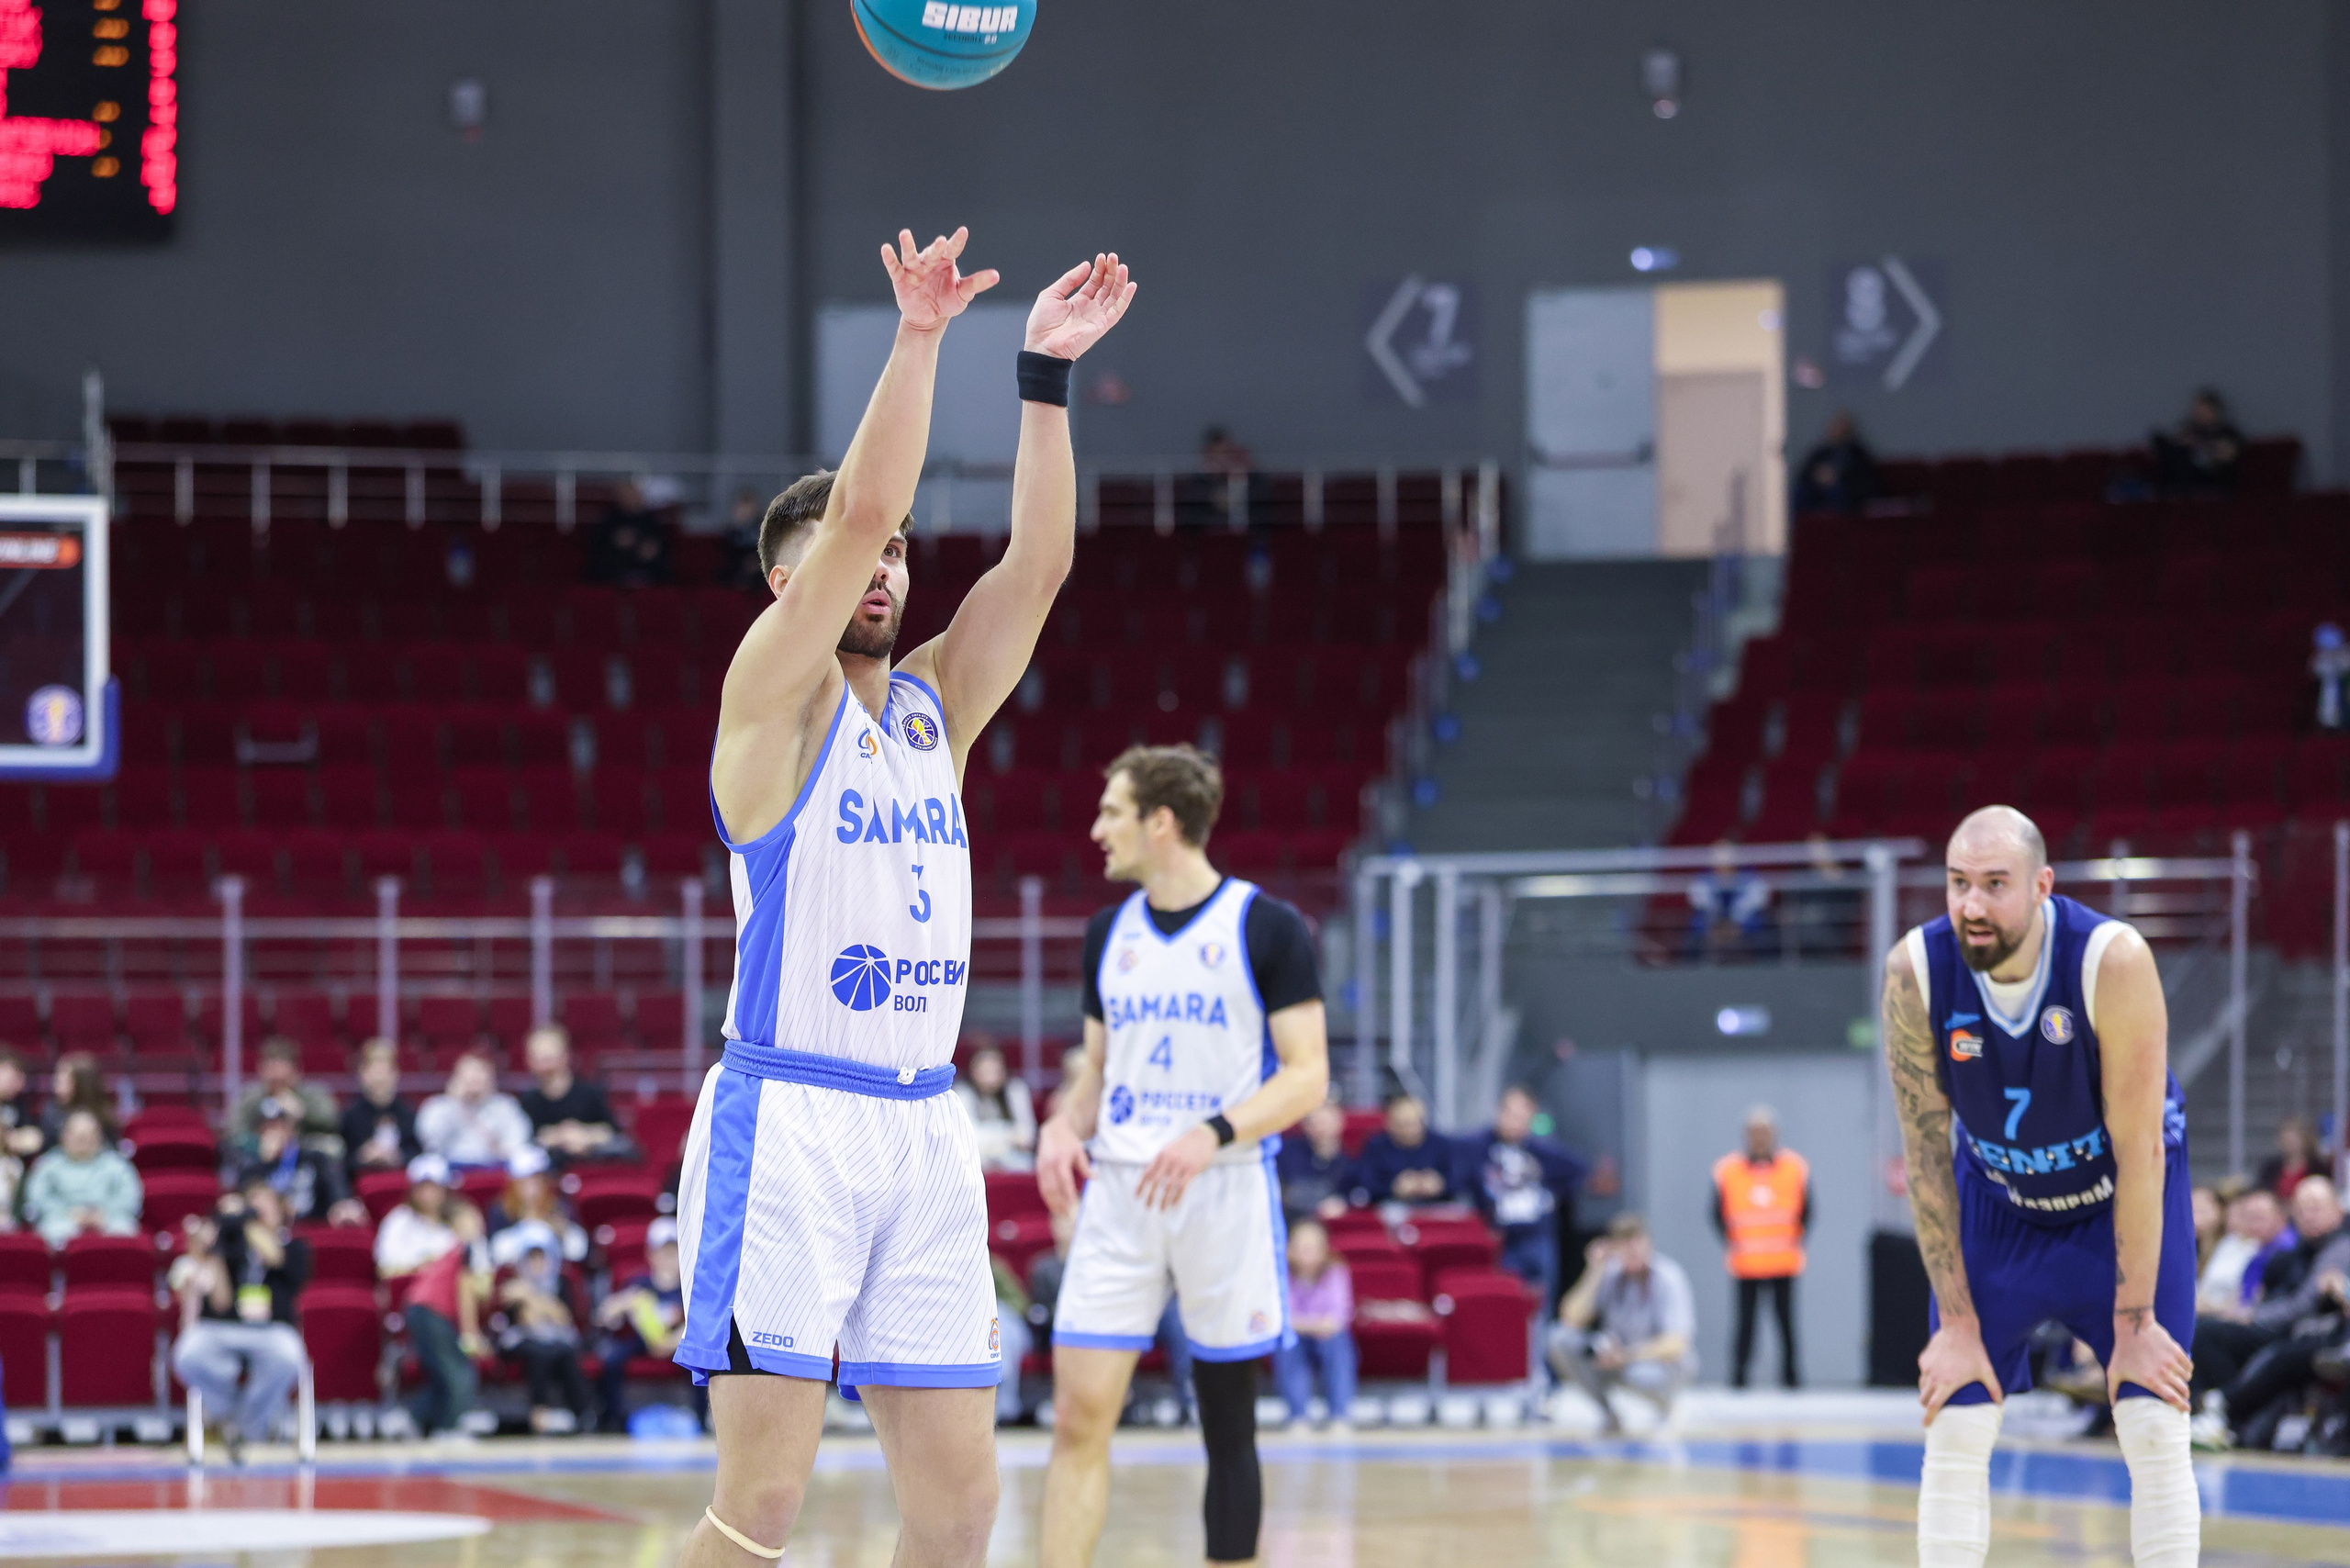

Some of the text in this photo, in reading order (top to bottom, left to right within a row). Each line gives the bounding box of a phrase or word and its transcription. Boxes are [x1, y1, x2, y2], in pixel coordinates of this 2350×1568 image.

[922, 0, 1018, 33] SIBUR
[909, 864, 932, 924] 3
[1108, 991, 1229, 1031] SAMARA
[1147, 1035, 1173, 1072] 4
[2004, 1087, 2031, 1141] 7
[1966, 1126, 2105, 1175] ENIT
[753, 1331, 794, 1348] ZEDO
